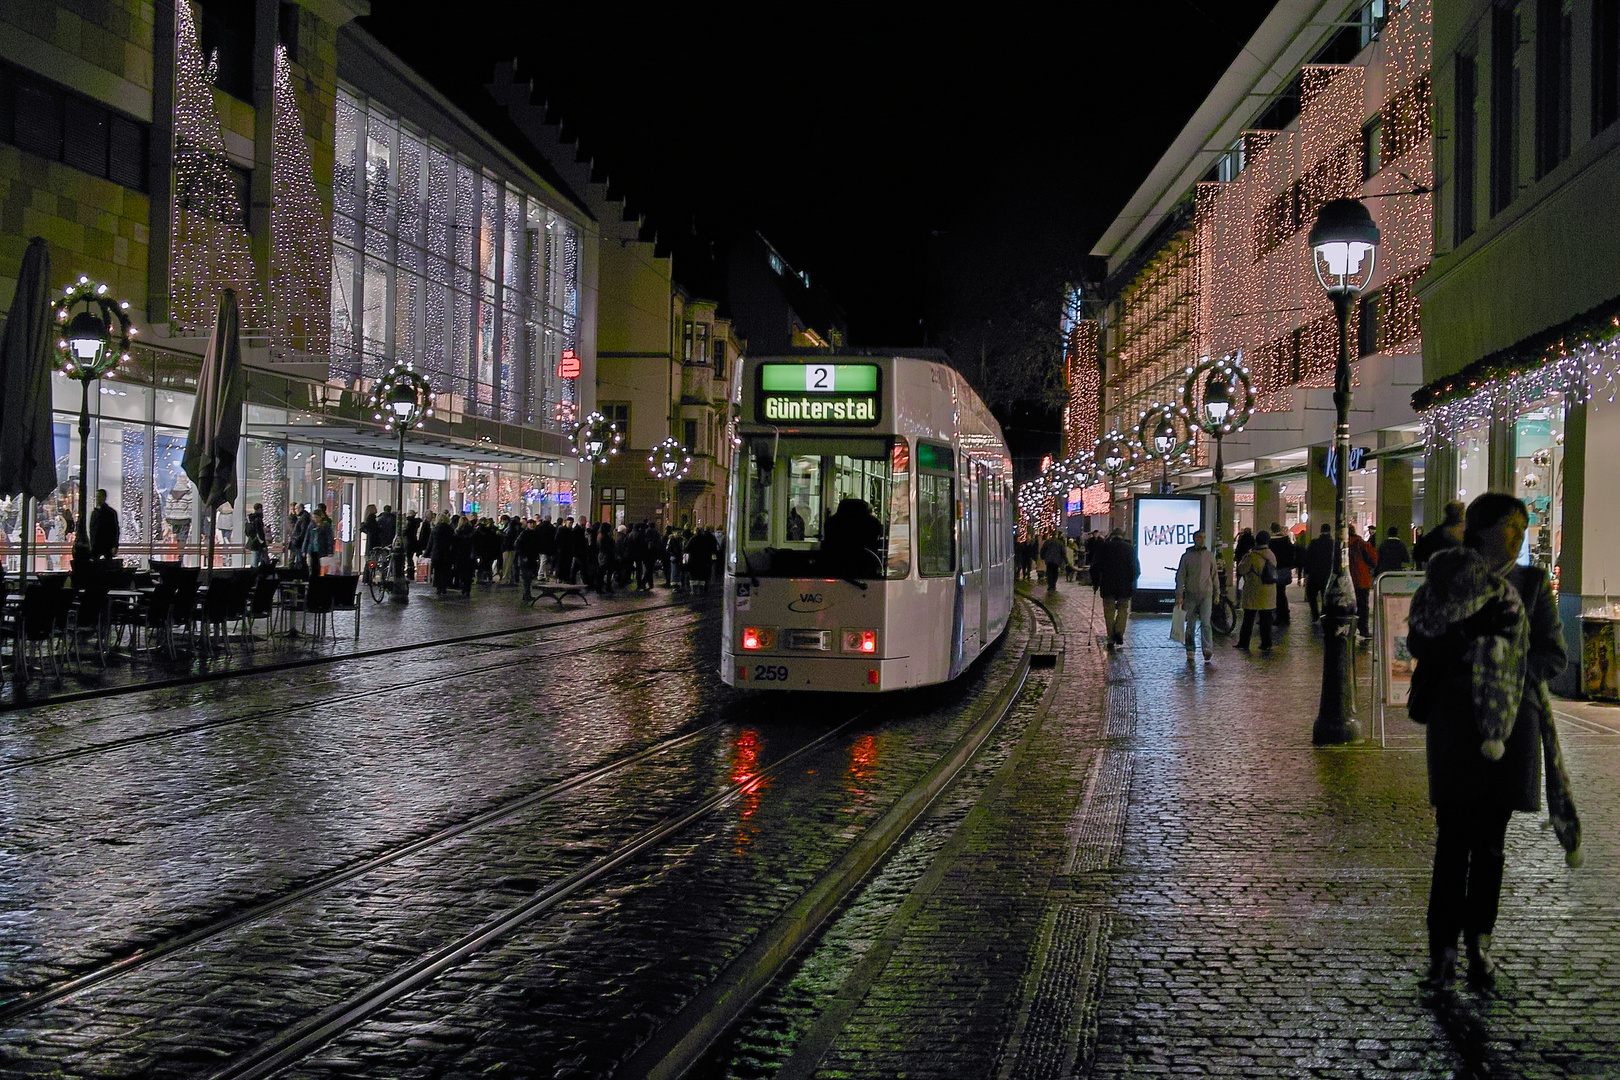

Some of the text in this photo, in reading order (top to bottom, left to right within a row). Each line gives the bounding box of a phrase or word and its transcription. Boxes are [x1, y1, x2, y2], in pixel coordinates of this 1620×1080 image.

[813, 367, 828, 389] 2
[766, 397, 875, 420] Günterstal
[1144, 524, 1195, 546] MAYBE
[800, 593, 823, 604] VAG
[754, 664, 788, 682] 259
